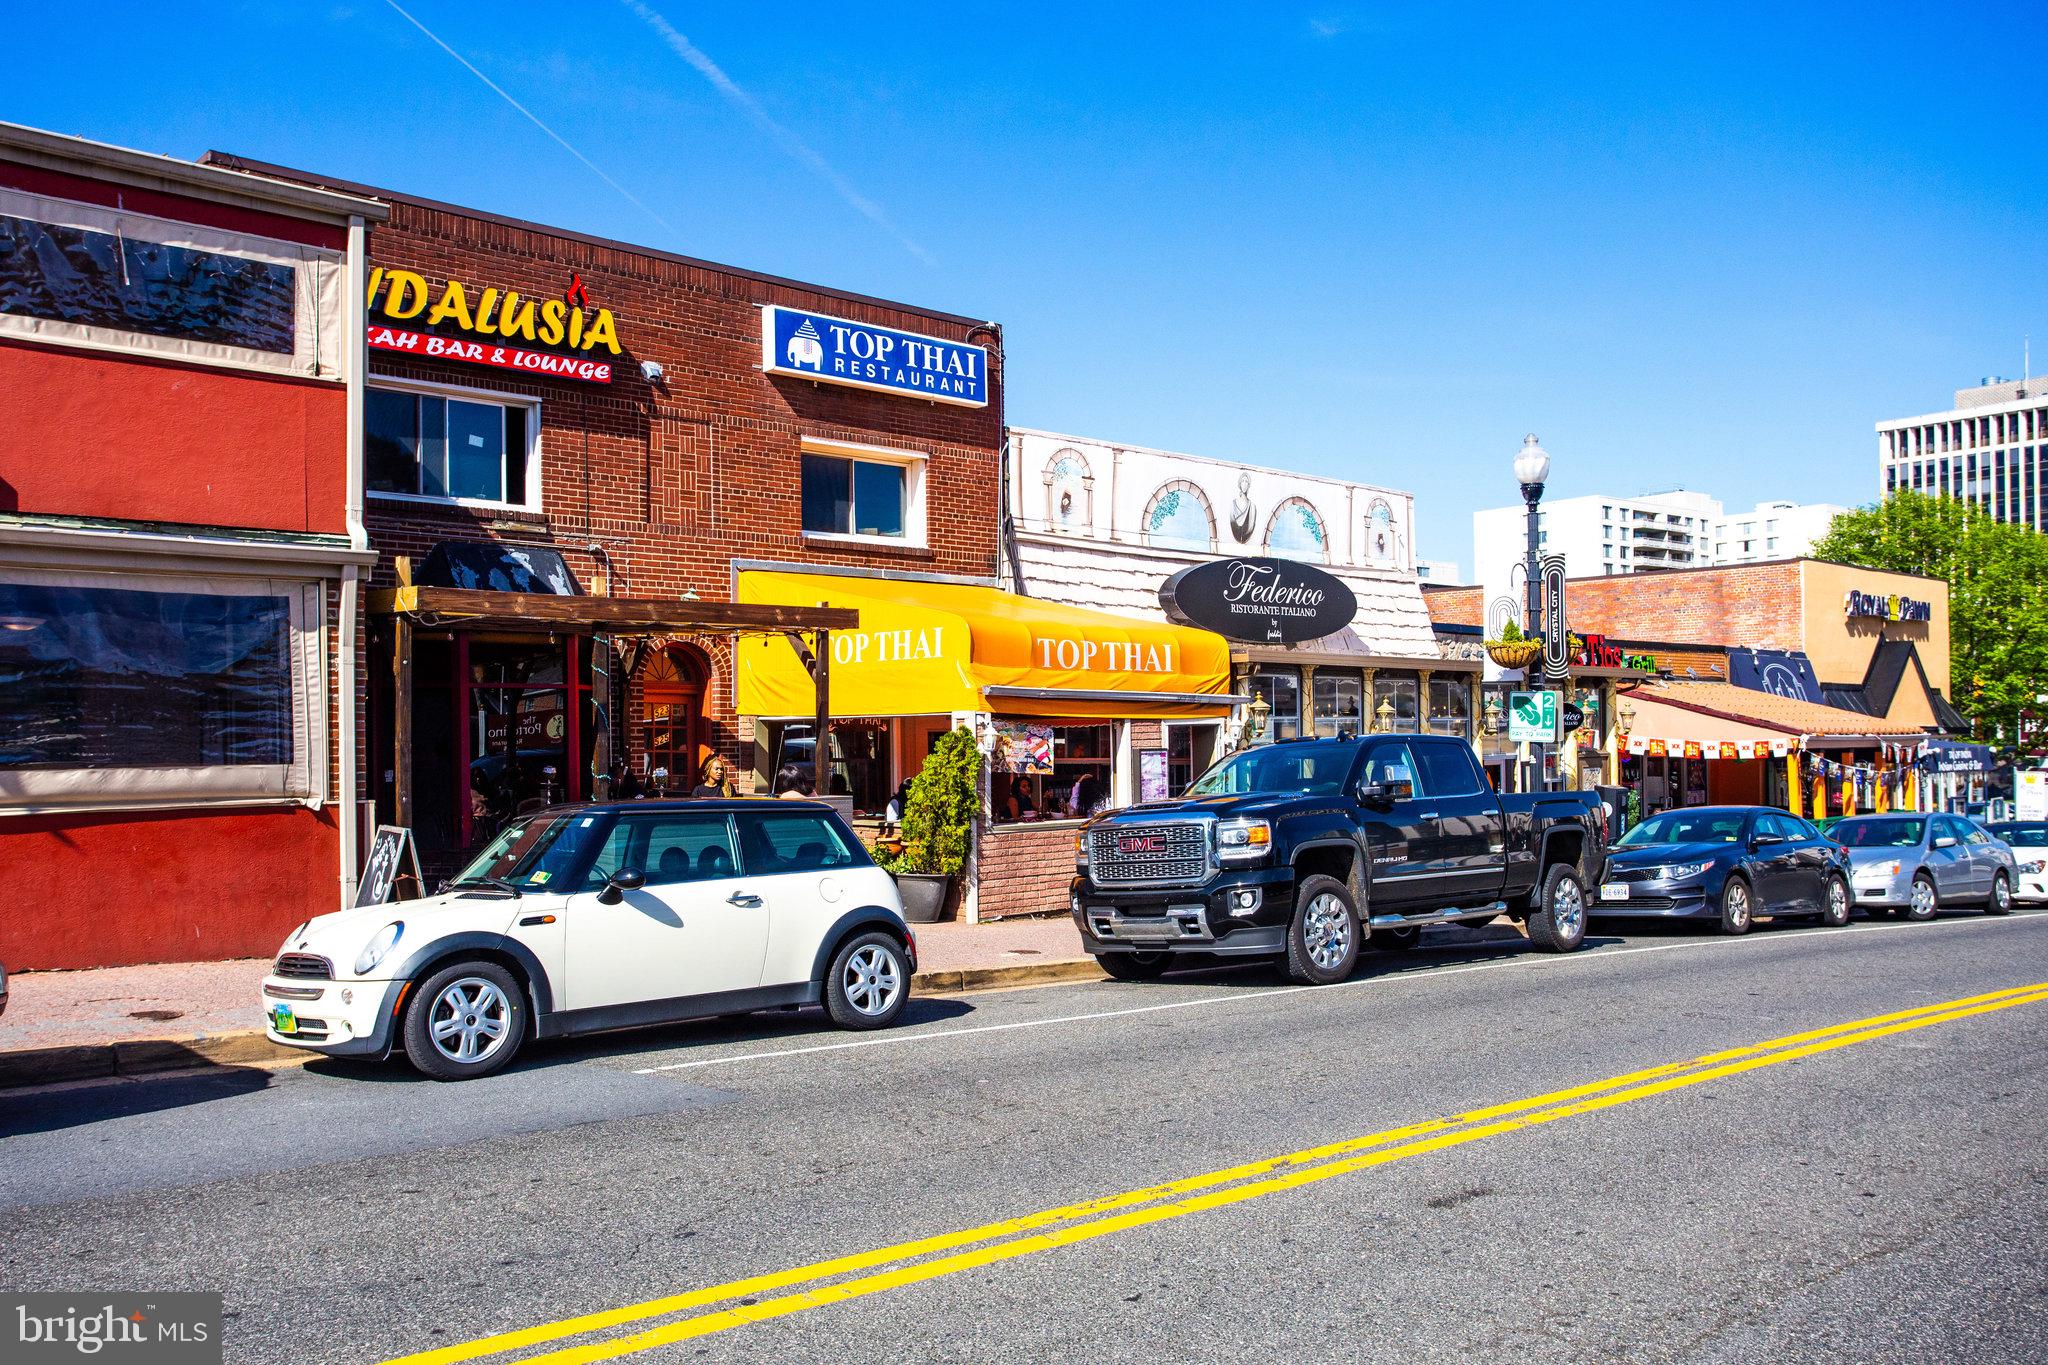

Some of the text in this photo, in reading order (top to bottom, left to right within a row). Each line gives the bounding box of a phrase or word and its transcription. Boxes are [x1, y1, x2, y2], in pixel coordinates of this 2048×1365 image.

[426, 337, 482, 360] BAR
[490, 348, 505, 363] &
[830, 325, 976, 379] TOP THAI
[834, 357, 977, 396] RESTAURANT
[1223, 561, 1325, 606] Federico
[1230, 603, 1317, 618] RISTORANTE ITALIANO
[1271, 618, 1278, 627] by
[1551, 608, 1559, 643] CRYSTAL
[874, 627, 944, 662] THAI
[1036, 638, 1173, 672] TOP THAI
[1544, 695, 1554, 708] 2
[1119, 836, 1166, 852] GMC
